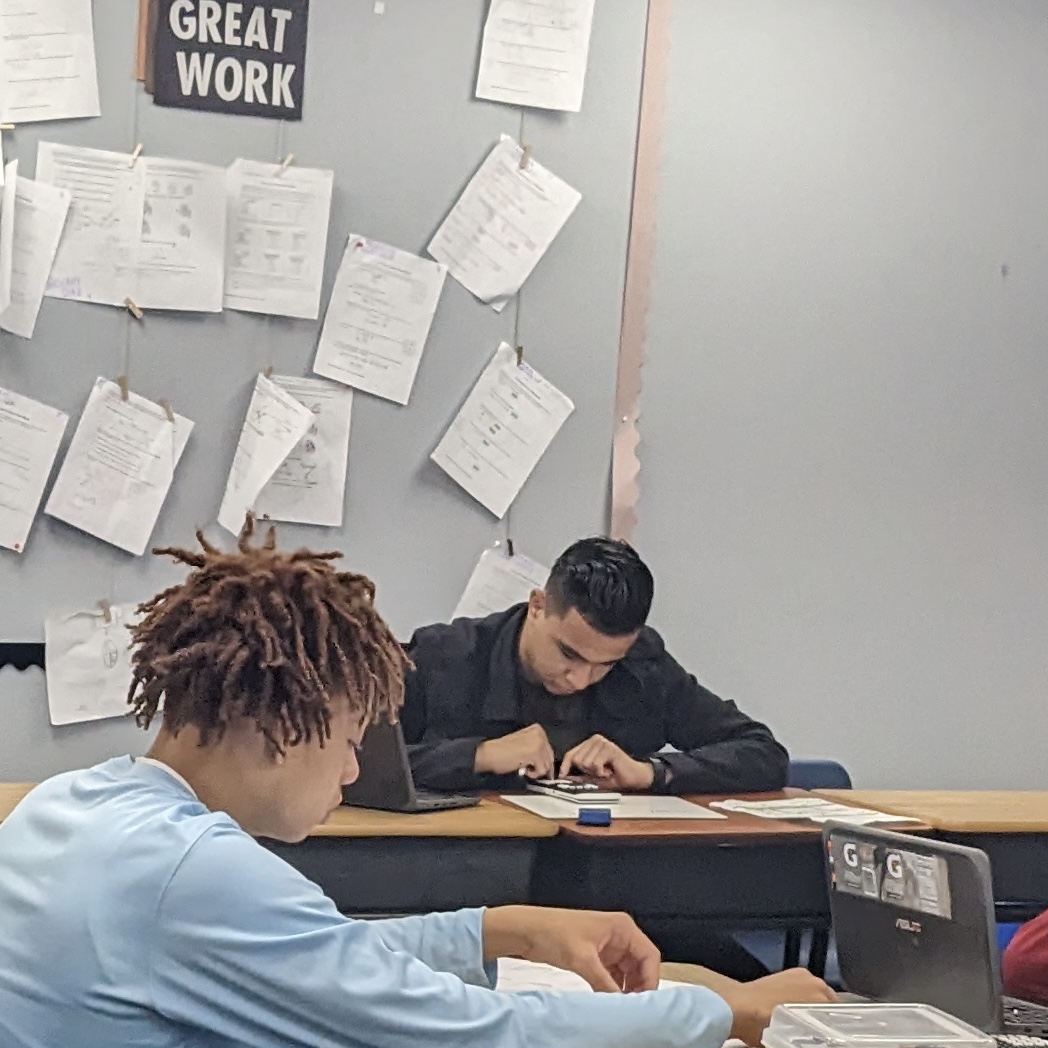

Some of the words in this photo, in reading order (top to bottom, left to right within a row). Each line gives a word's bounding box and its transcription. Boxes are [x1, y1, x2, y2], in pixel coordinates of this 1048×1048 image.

[169, 0, 292, 53] GREAT
[176, 51, 296, 109] WORK
[844, 843, 858, 867] G
[887, 854, 903, 878] G
